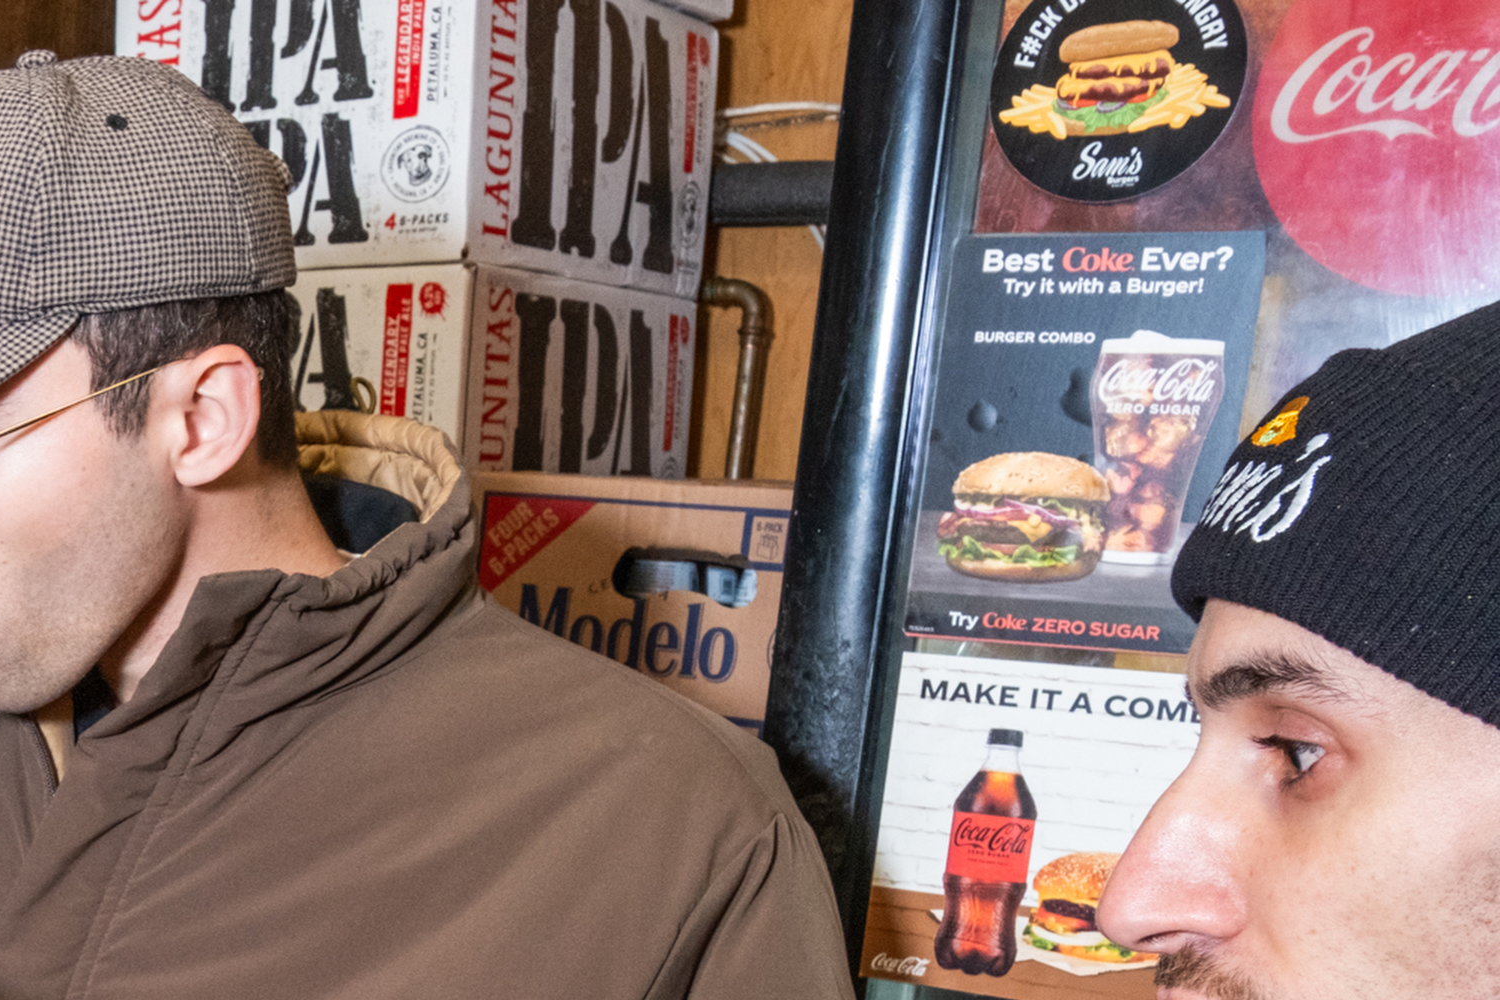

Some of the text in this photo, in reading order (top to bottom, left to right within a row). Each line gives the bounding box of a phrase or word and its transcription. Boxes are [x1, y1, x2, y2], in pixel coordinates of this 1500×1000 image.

[1014, 6, 1063, 68] F#CK
[511, 0, 674, 275] IPA
[1072, 141, 1144, 180] Sam's
[384, 212, 449, 230] 4 6-PACKS
[982, 246, 1234, 273] Best Coke Ever?
[1003, 277, 1205, 297] Try it with a Burger!
[974, 331, 1096, 345] BURGER COMBO
[383, 316, 398, 406] LEGENDARY
[479, 287, 515, 471] UNITAS
[1098, 358, 1219, 403] Coca-Cola
[1106, 402, 1201, 416] ZERO SUGAR
[488, 501, 535, 549] FOUR
[488, 507, 560, 577] 6-PACKS
[519, 583, 739, 684] Modelo
[949, 610, 979, 630] Try
[982, 611, 1028, 630] Coke
[1032, 617, 1086, 635] ZERO
[1089, 622, 1161, 641] SUGAR
[920, 678, 1020, 707] MAKE
[1030, 688, 1062, 711] IT
[1069, 692, 1093, 715] A
[954, 817, 1030, 854] Coca-Cola
